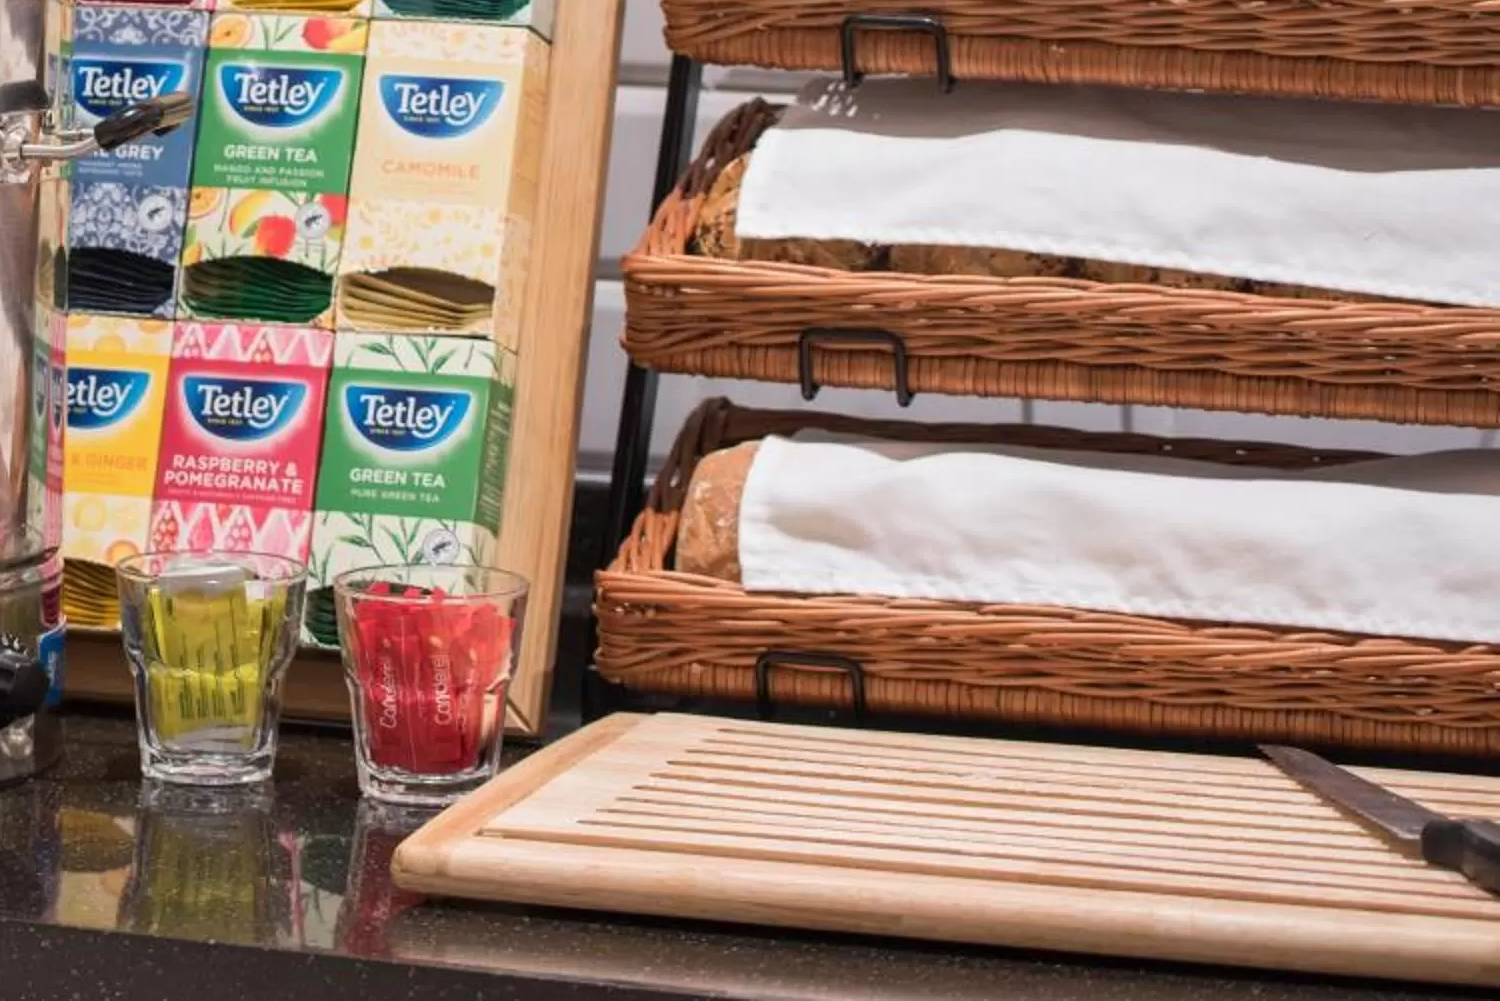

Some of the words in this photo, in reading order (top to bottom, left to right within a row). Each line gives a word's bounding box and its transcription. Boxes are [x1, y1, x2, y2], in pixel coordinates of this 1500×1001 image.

[78, 66, 169, 105] Tetley
[233, 73, 327, 116] Tetley
[393, 83, 488, 126] Tetley
[115, 144, 164, 161] GREY
[223, 144, 280, 160] GREEN
[285, 147, 318, 164] TEA
[381, 159, 481, 180] CAMOMILE
[67, 375, 133, 417] etley
[198, 384, 291, 429] Tetley
[360, 394, 456, 439] Tetley
[172, 455, 281, 476] RASPBERRY
[285, 462, 298, 478] &
[350, 467, 408, 485] GREEN
[411, 472, 446, 489] TEA
[164, 471, 305, 496] POMEGRANATE
[380, 490, 417, 502] GREEN
[419, 492, 441, 504] TEA
